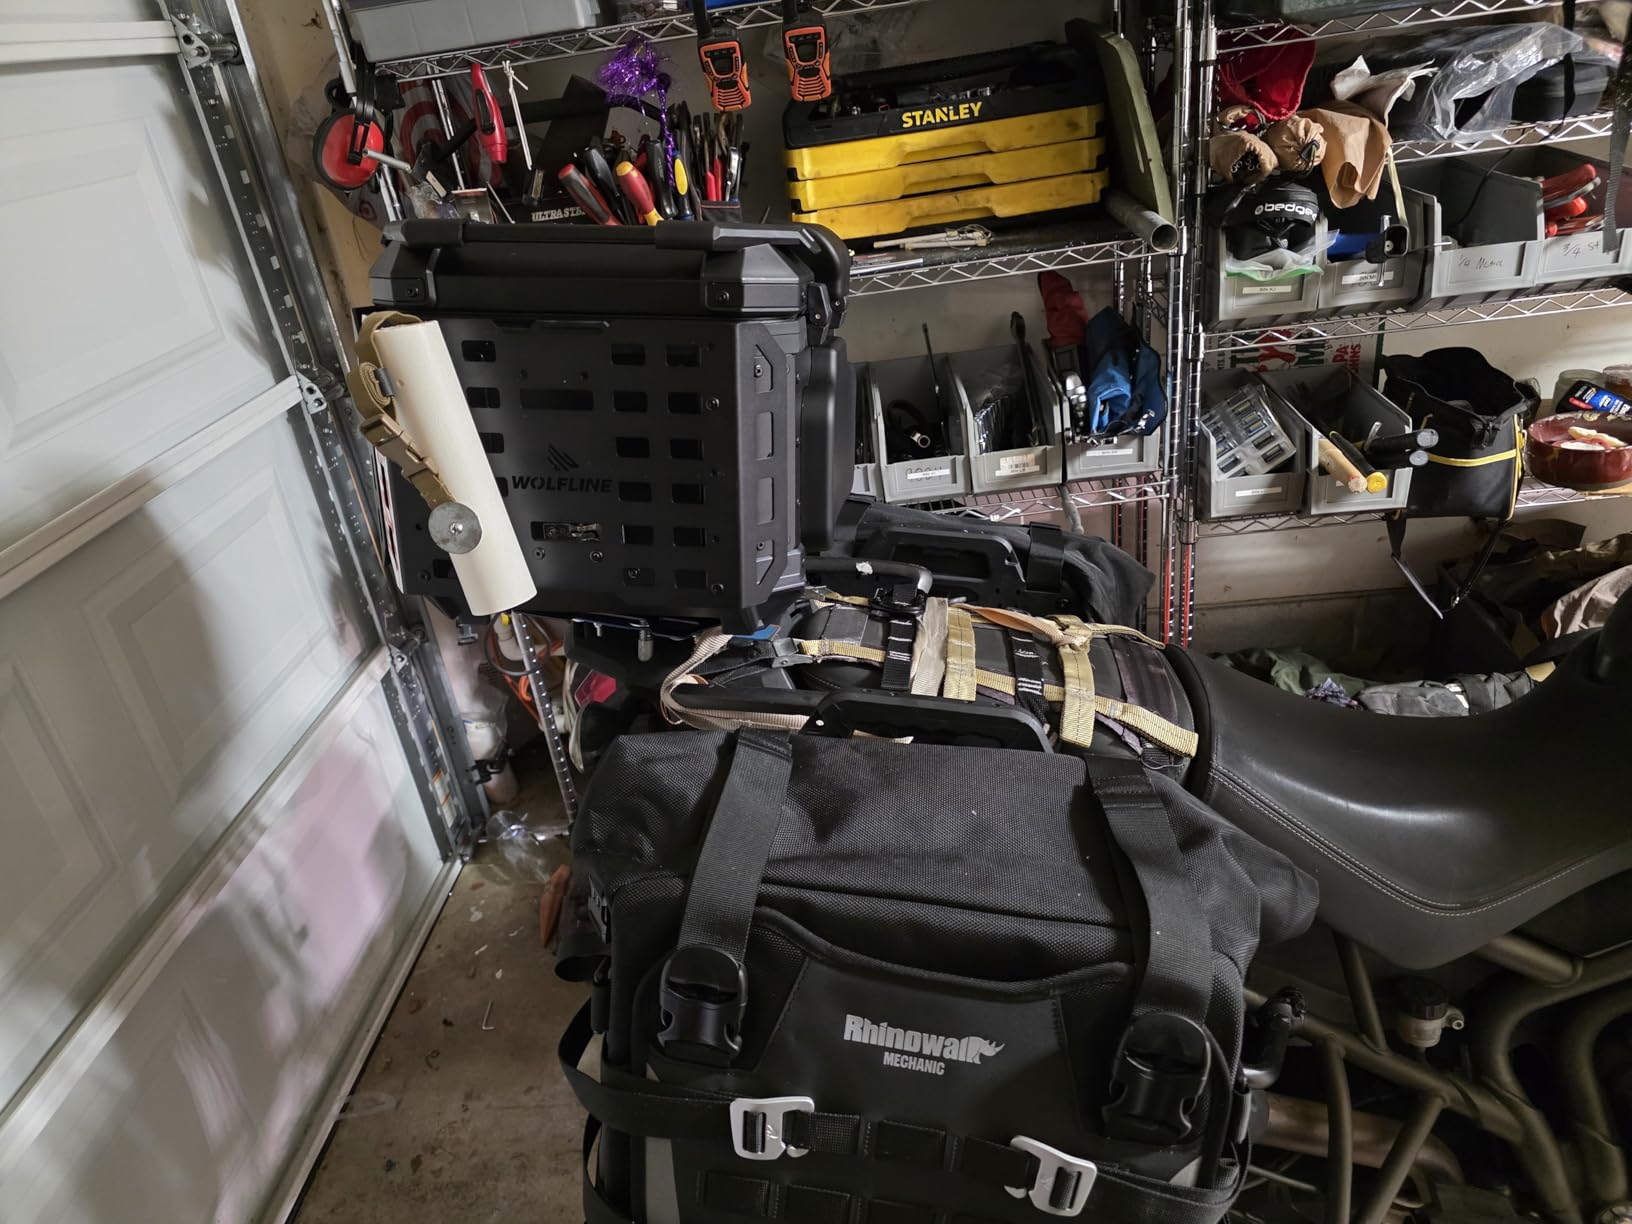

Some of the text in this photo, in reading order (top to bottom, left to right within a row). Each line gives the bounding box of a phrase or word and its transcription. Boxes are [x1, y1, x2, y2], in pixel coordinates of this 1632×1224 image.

[901, 101, 983, 128] STANLEY
[511, 475, 614, 493] WOLFLINE
[883, 1051, 946, 1076] MECHANIC
